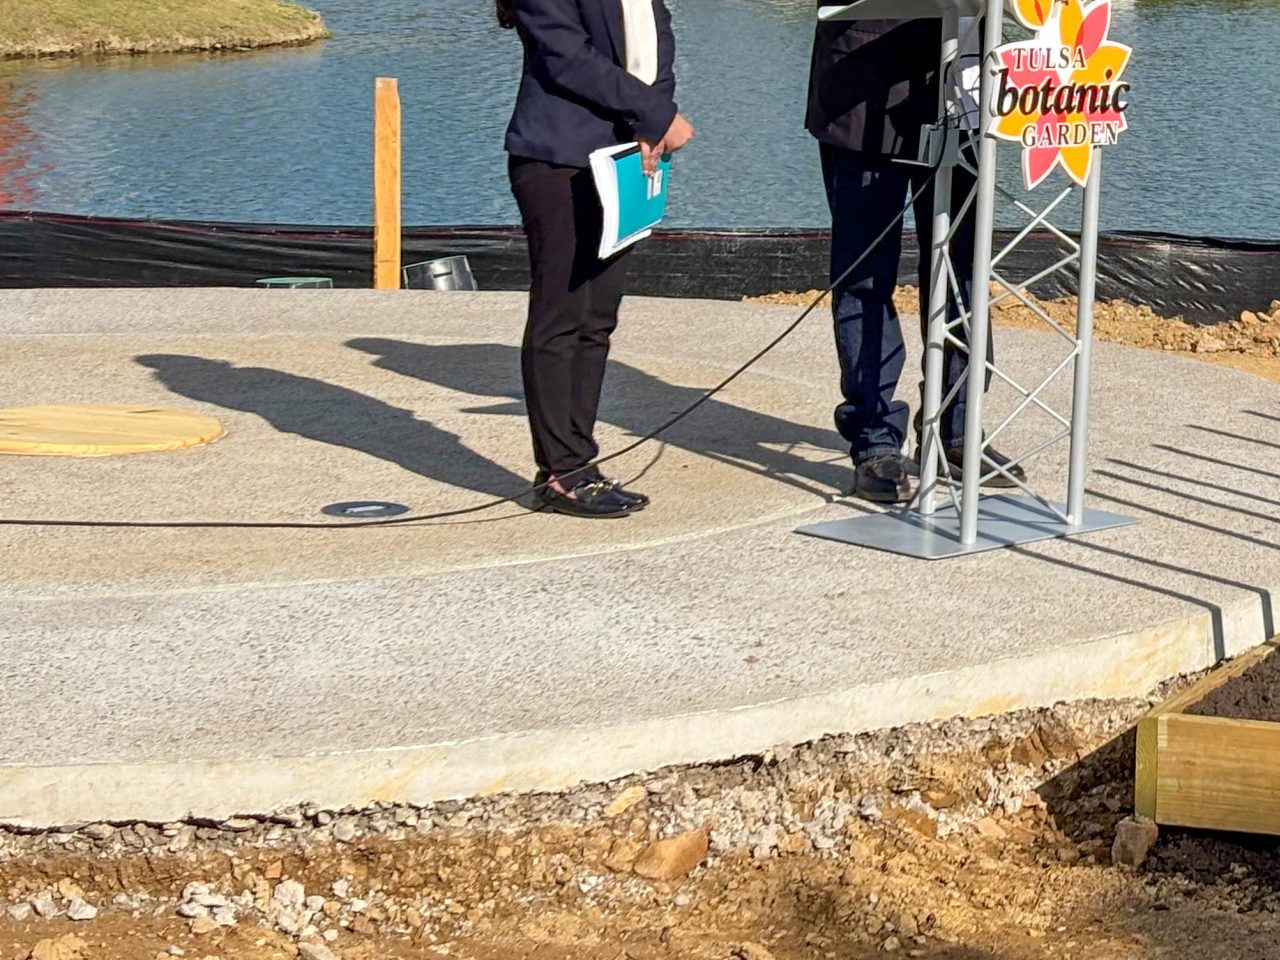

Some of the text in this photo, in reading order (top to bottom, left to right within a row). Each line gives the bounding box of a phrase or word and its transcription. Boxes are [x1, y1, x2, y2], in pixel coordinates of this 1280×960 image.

[1013, 46, 1087, 70] TULSA
[996, 68, 1131, 117] botanic
[1022, 122, 1119, 148] GARDEN
